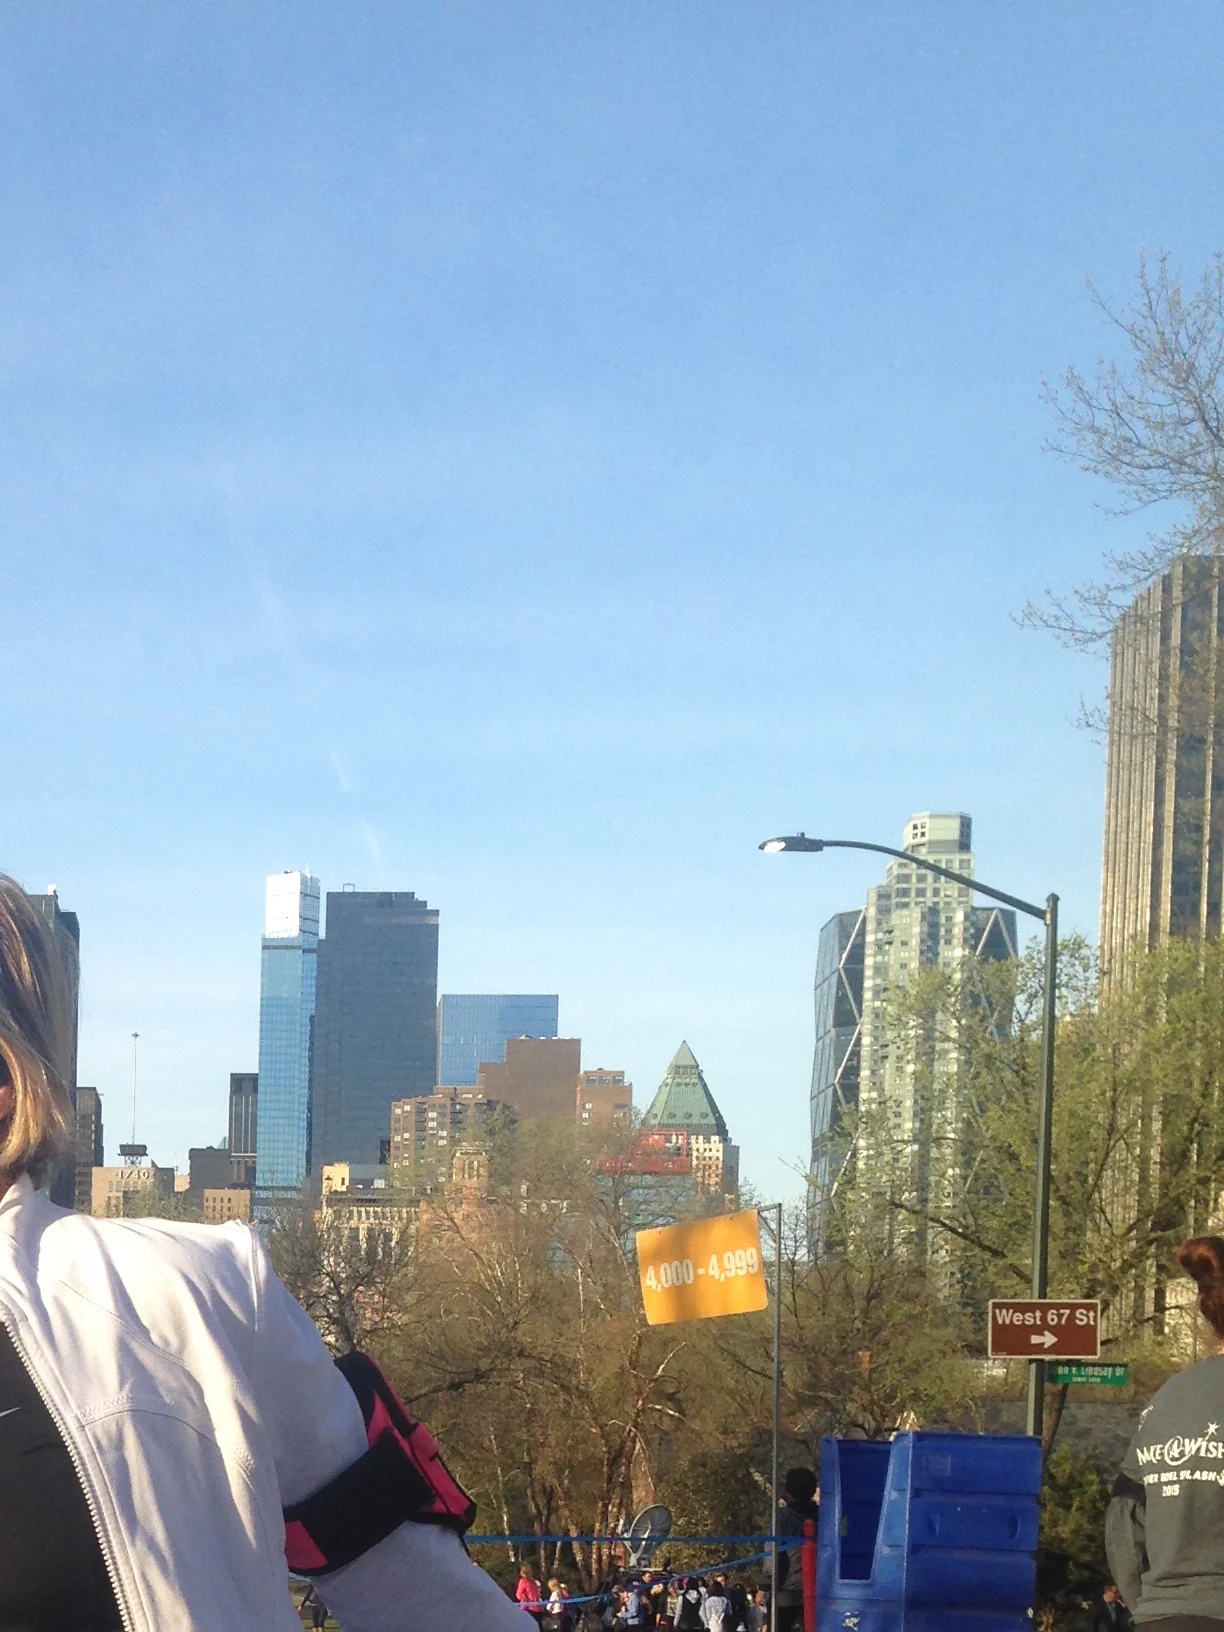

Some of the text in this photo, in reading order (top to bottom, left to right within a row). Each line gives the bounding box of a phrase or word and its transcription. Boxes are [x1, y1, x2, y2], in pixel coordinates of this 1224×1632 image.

[645, 1258, 695, 1292] 4,000
[708, 1246, 759, 1282] 4,999
[995, 1308, 1096, 1326] West 67 St
